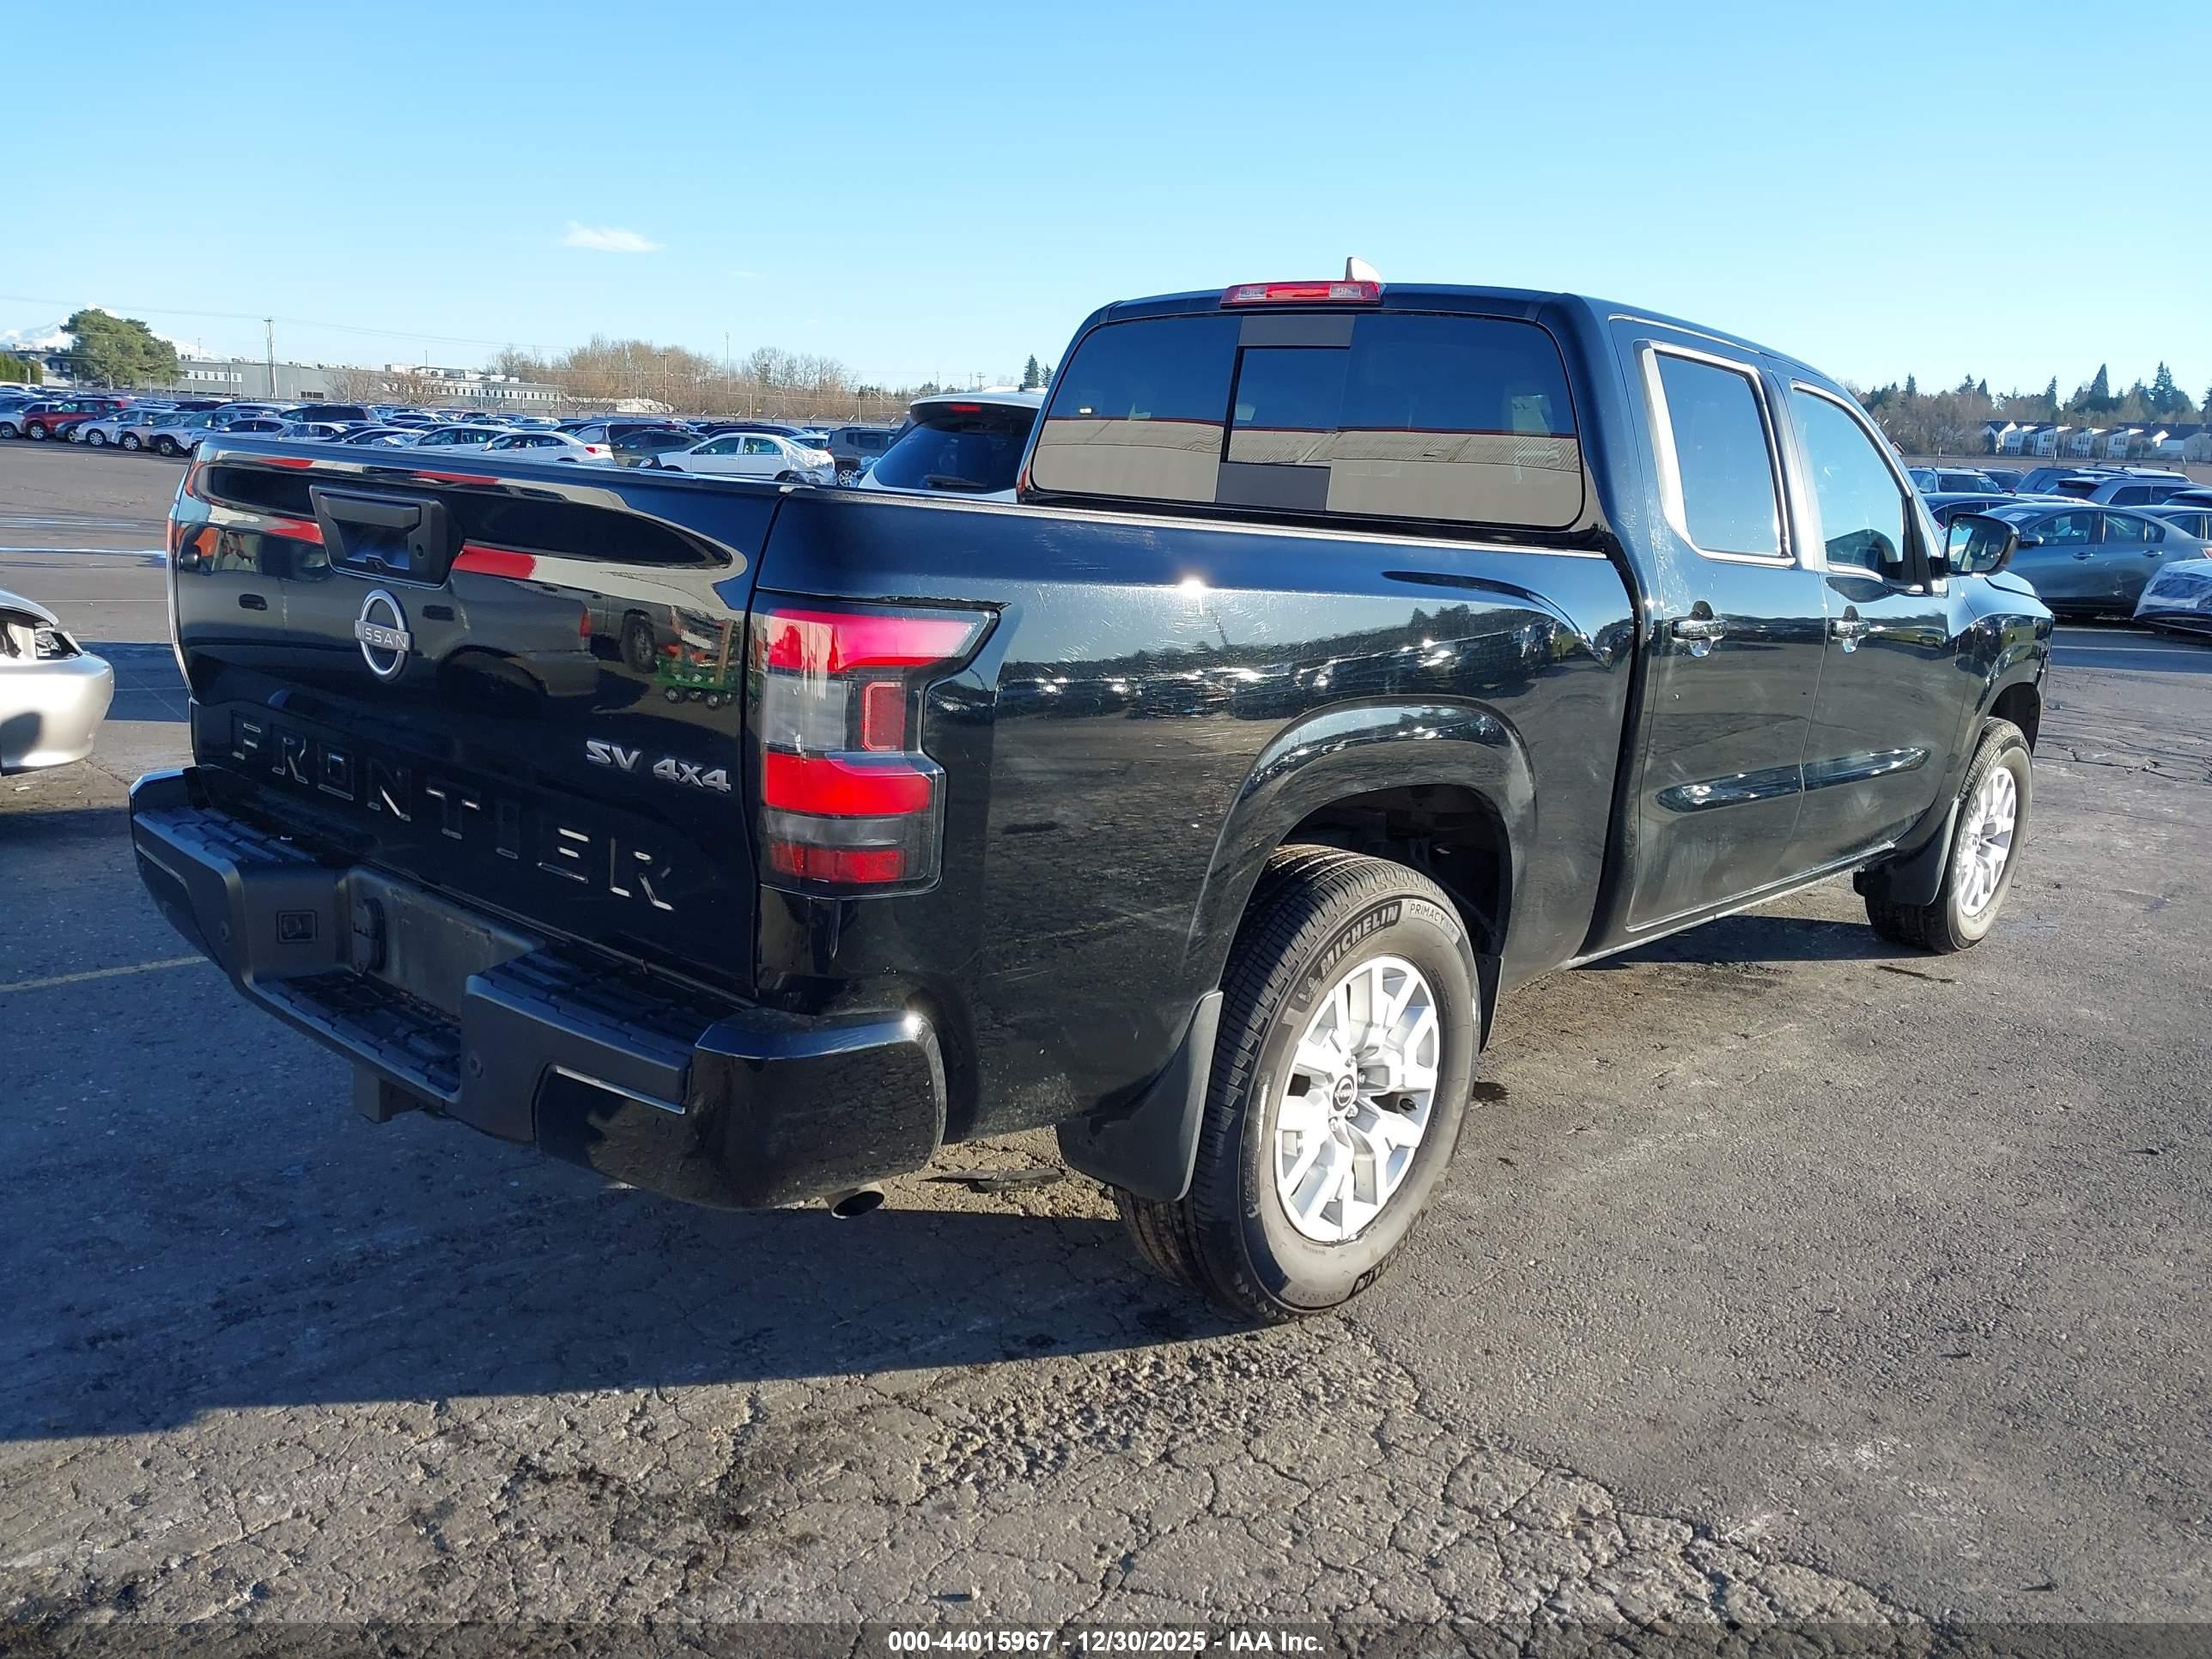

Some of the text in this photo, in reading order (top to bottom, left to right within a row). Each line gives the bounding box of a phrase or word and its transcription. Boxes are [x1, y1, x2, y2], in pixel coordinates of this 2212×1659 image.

[355, 620, 408, 649] NISSAN
[586, 739, 641, 771] SV
[229, 708, 676, 912] FRONTIER
[1409, 902, 1446, 925] PRIMACY
[1319, 904, 1400, 977] MICHELIN
